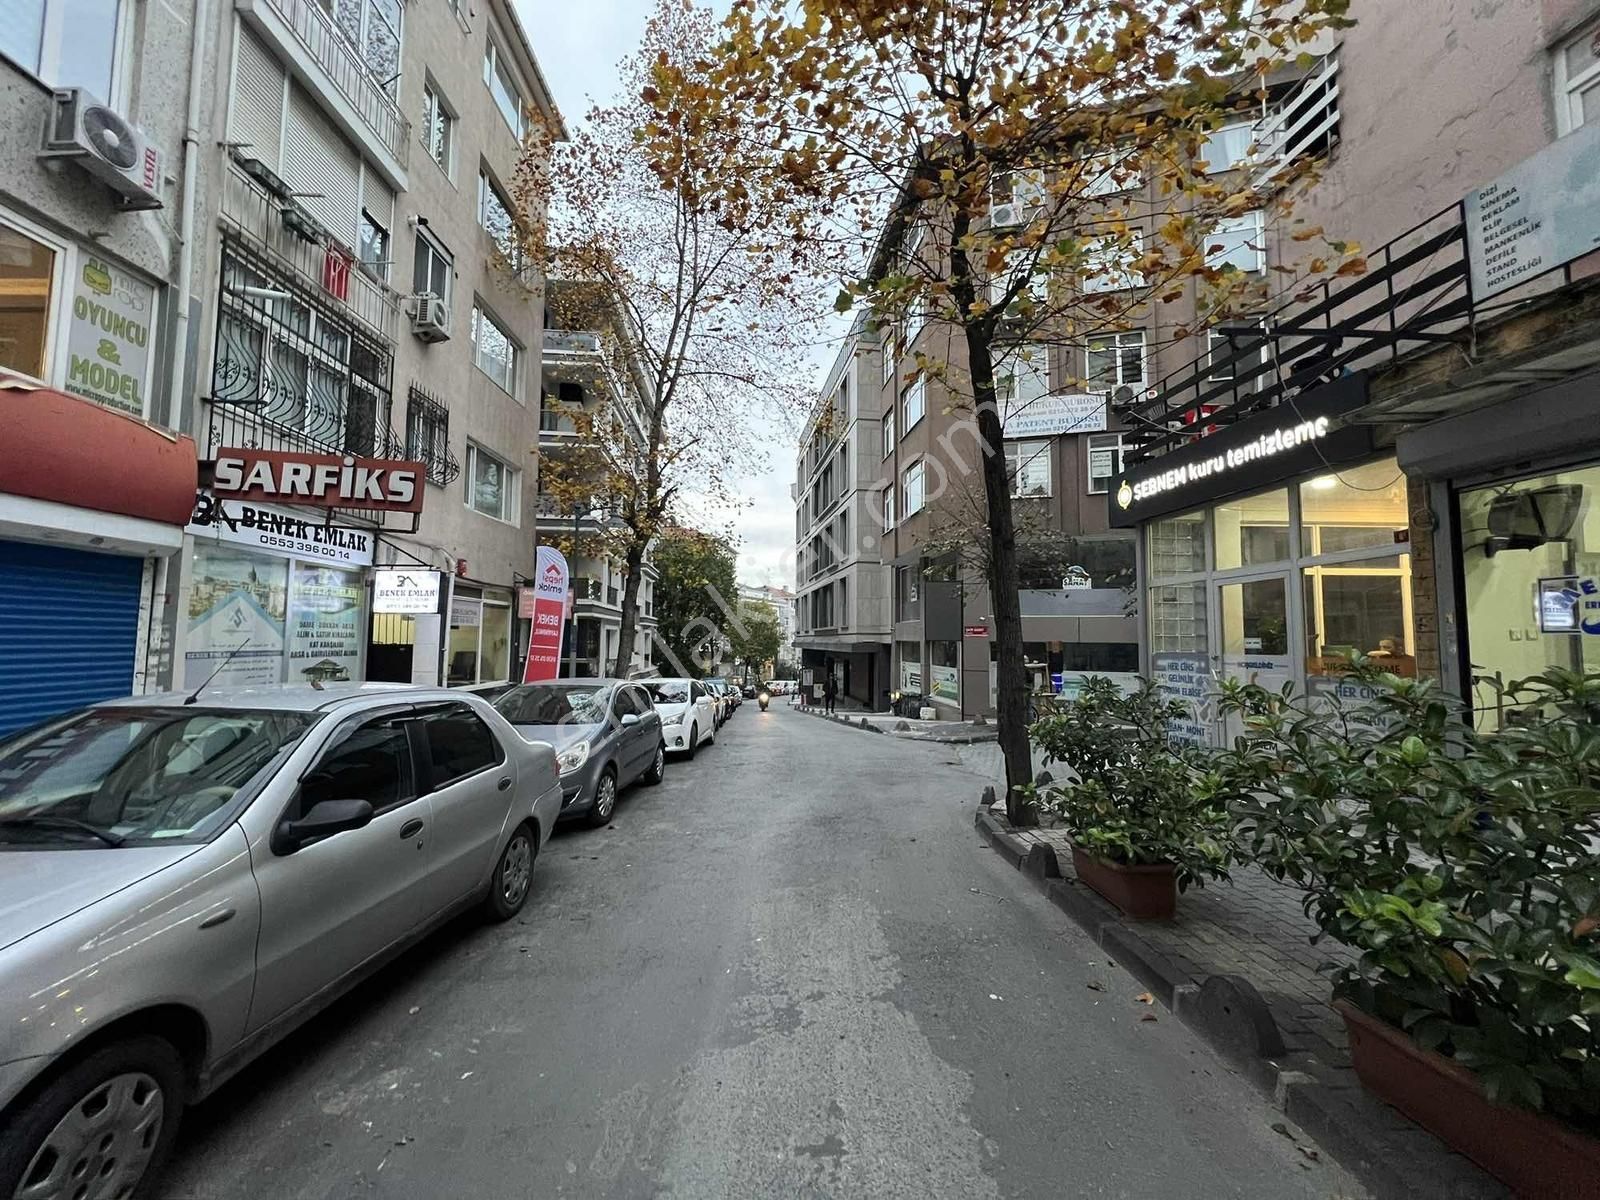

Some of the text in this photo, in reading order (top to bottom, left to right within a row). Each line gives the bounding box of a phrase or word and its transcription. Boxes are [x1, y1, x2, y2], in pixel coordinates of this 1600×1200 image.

[1479, 184, 1498, 201] DİZİ
[1480, 187, 1517, 211] SİNEMA
[1481, 196, 1520, 222] REKLAM
[1482, 218, 1502, 233] KLİP
[1483, 216, 1529, 244] BELGESEL
[1484, 221, 1542, 255] MANKENLİK
[1485, 245, 1517, 266] DEFİLE
[1486, 258, 1518, 278] STAND
[1487, 256, 1542, 288] HOSTESLİĞİ
[74, 296, 148, 348] OYUNCU
[97, 339, 122, 367] &
[69, 354, 143, 404] MODEL
[1188, 453, 1225, 480] kuru
[1226, 416, 1330, 469] temizleme
[213, 456, 416, 503] SARFİKS
[240, 506, 367, 552] BENEK EMLAK
[259, 534, 350, 560] 0553 396 00 14
[1335, 685, 1357, 697] HER
